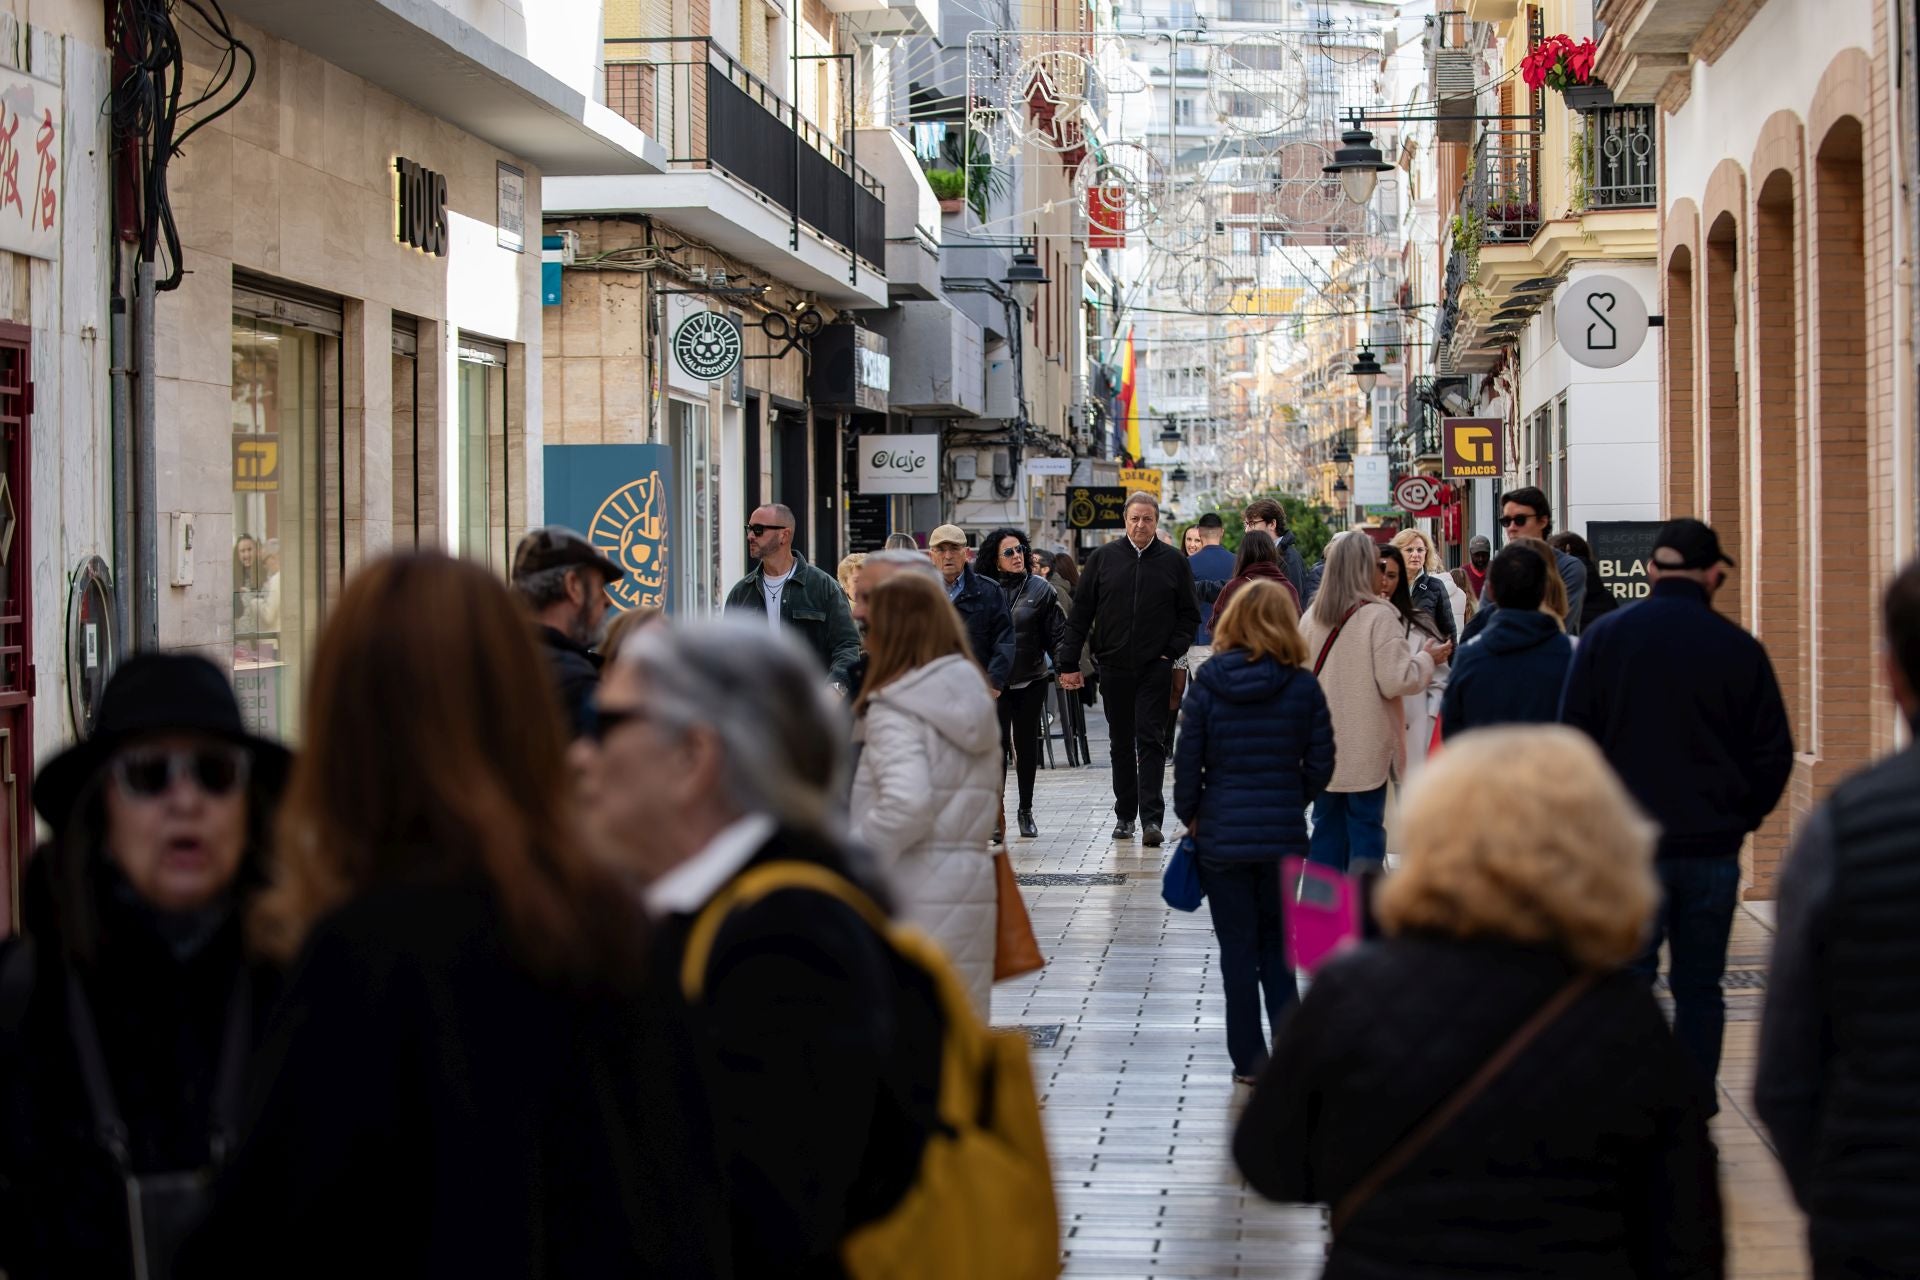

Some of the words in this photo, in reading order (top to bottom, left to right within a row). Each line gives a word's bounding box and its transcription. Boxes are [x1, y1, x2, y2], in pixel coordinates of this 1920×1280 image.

[396, 156, 448, 257] TOUS
[682, 353, 735, 375] MALAESQUINA
[871, 450, 926, 473] Olaje
[1453, 466, 1497, 476] TABACOS
[1599, 559, 1647, 577] BLA
[610, 578, 664, 608] ALAES
